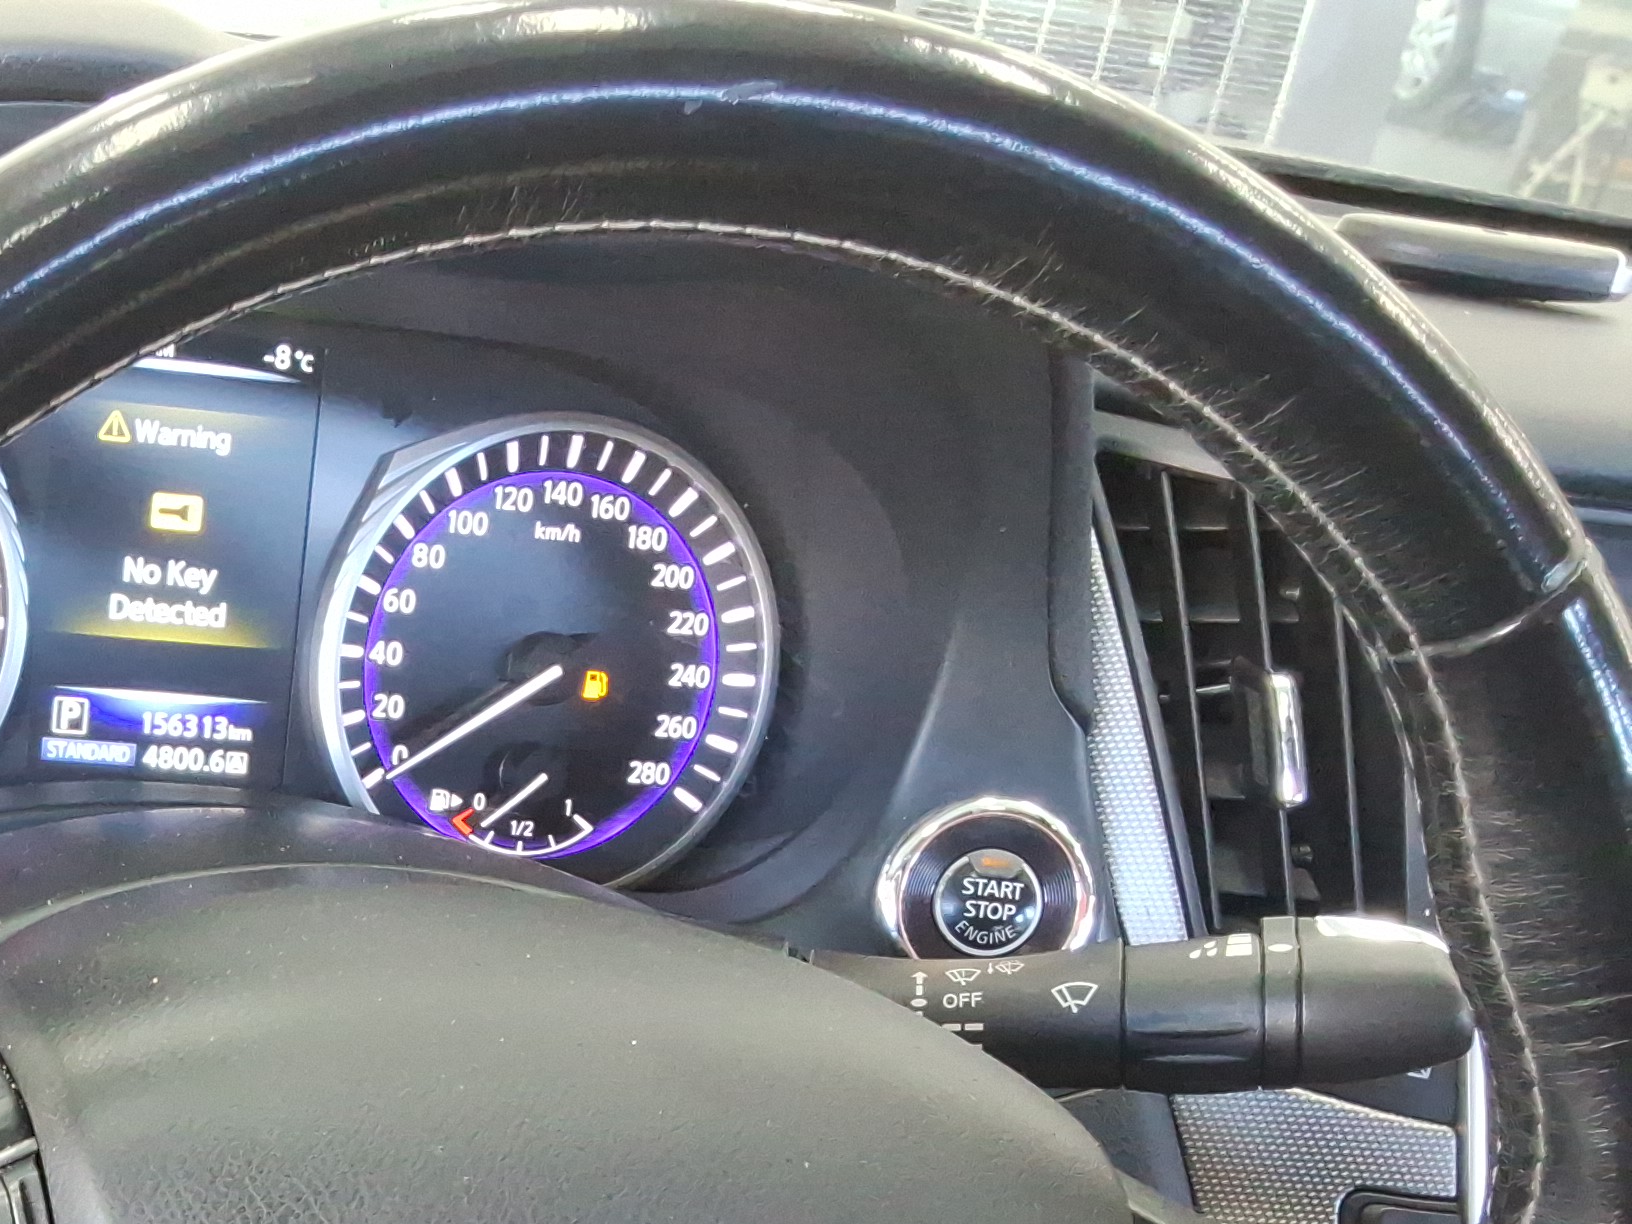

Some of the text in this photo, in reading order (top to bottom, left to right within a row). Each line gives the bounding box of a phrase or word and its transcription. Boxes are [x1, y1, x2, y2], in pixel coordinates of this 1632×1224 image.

[135, 418, 232, 456] Warning
[494, 486, 533, 513] 120
[543, 480, 583, 507] 140
[591, 494, 630, 521] 160
[449, 510, 489, 537] 100
[534, 520, 581, 544] km/h
[627, 526, 668, 552] 180
[412, 543, 446, 569] 80
[123, 555, 218, 595] No Key
[651, 563, 694, 590] 200
[108, 592, 227, 628] Detected
[383, 588, 417, 614] 60
[667, 610, 709, 636] 220
[369, 641, 403, 666] 40
[669, 663, 710, 689] 240
[59, 700, 82, 731] P
[372, 693, 406, 720] 20
[654, 714, 697, 740] 260
[46, 740, 131, 763] STANDARD
[142, 744, 225, 773] 4800.6
[627, 760, 670, 786] 280
[473, 792, 486, 811] 0
[565, 799, 573, 817] 1
[510, 820, 534, 837] 1/2
[962, 877, 1025, 900] START
[963, 900, 1017, 921] STOP
[954, 920, 1018, 945] ENGINE
[943, 992, 982, 1008] OFF
